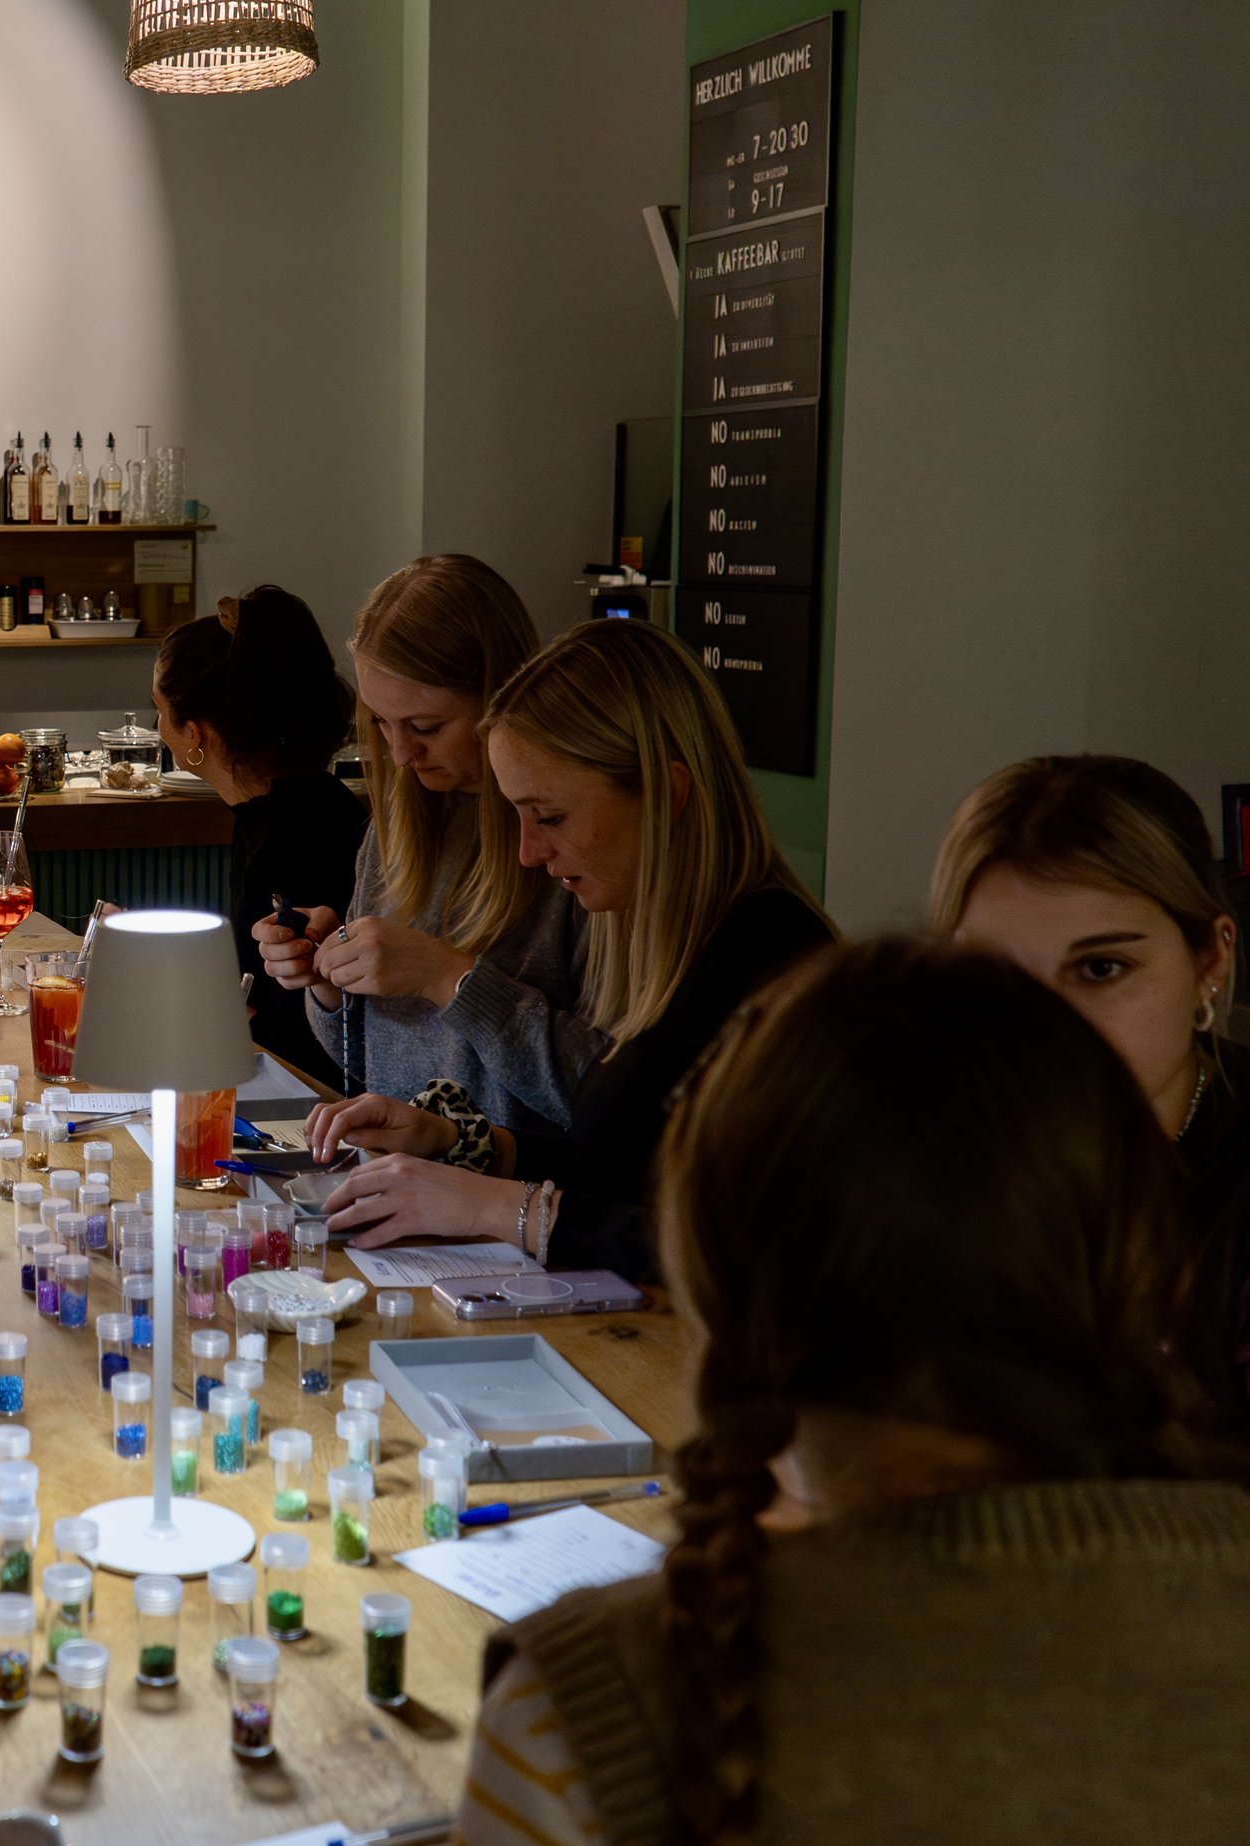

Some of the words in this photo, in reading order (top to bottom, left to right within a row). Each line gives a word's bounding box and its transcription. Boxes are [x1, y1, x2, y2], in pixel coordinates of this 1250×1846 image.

[695, 68, 743, 105] HERZLICH
[749, 44, 812, 87] WILLKOMME
[751, 182, 784, 214] 9-17
[717, 239, 779, 275] KAFFEEBAR
[714, 293, 728, 319] JA
[714, 332, 727, 359] JA
[713, 375, 726, 402] JA
[711, 420, 728, 444] NO
[710, 464, 727, 488] NO
[709, 508, 726, 532] NO
[708, 551, 725, 575] NO
[704, 601, 721, 625] NO
[703, 646, 720, 670] NO
